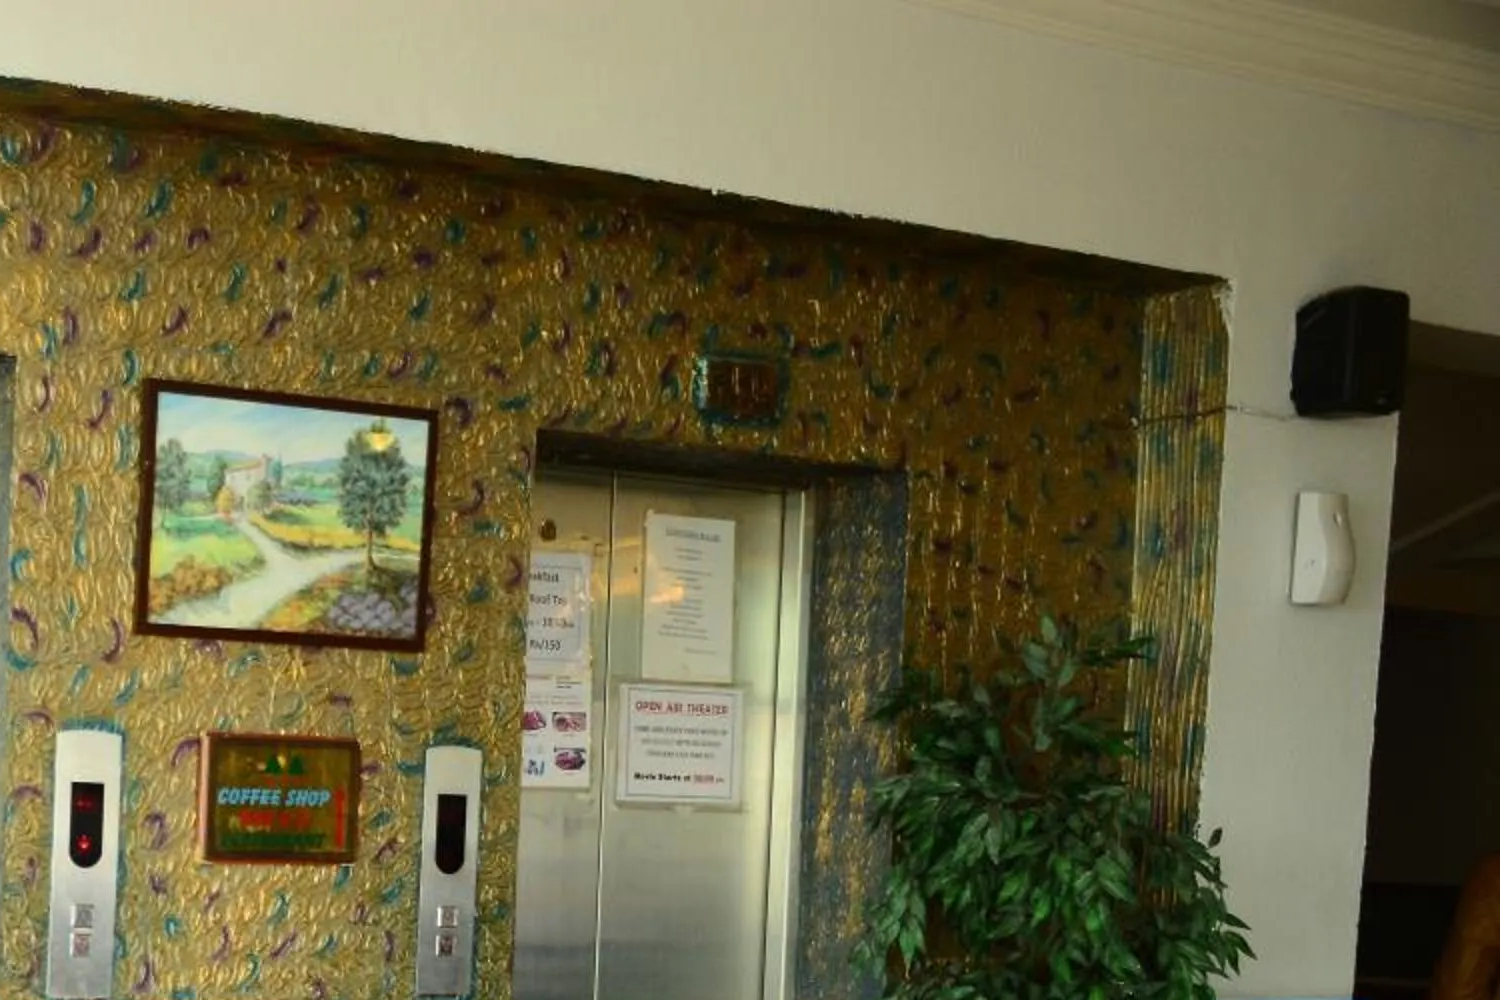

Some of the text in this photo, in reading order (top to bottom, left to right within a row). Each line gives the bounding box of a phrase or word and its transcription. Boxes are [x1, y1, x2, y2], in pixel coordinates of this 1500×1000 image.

[635, 700, 662, 713] OPEN
[217, 787, 332, 808] COFFEE SHOP
